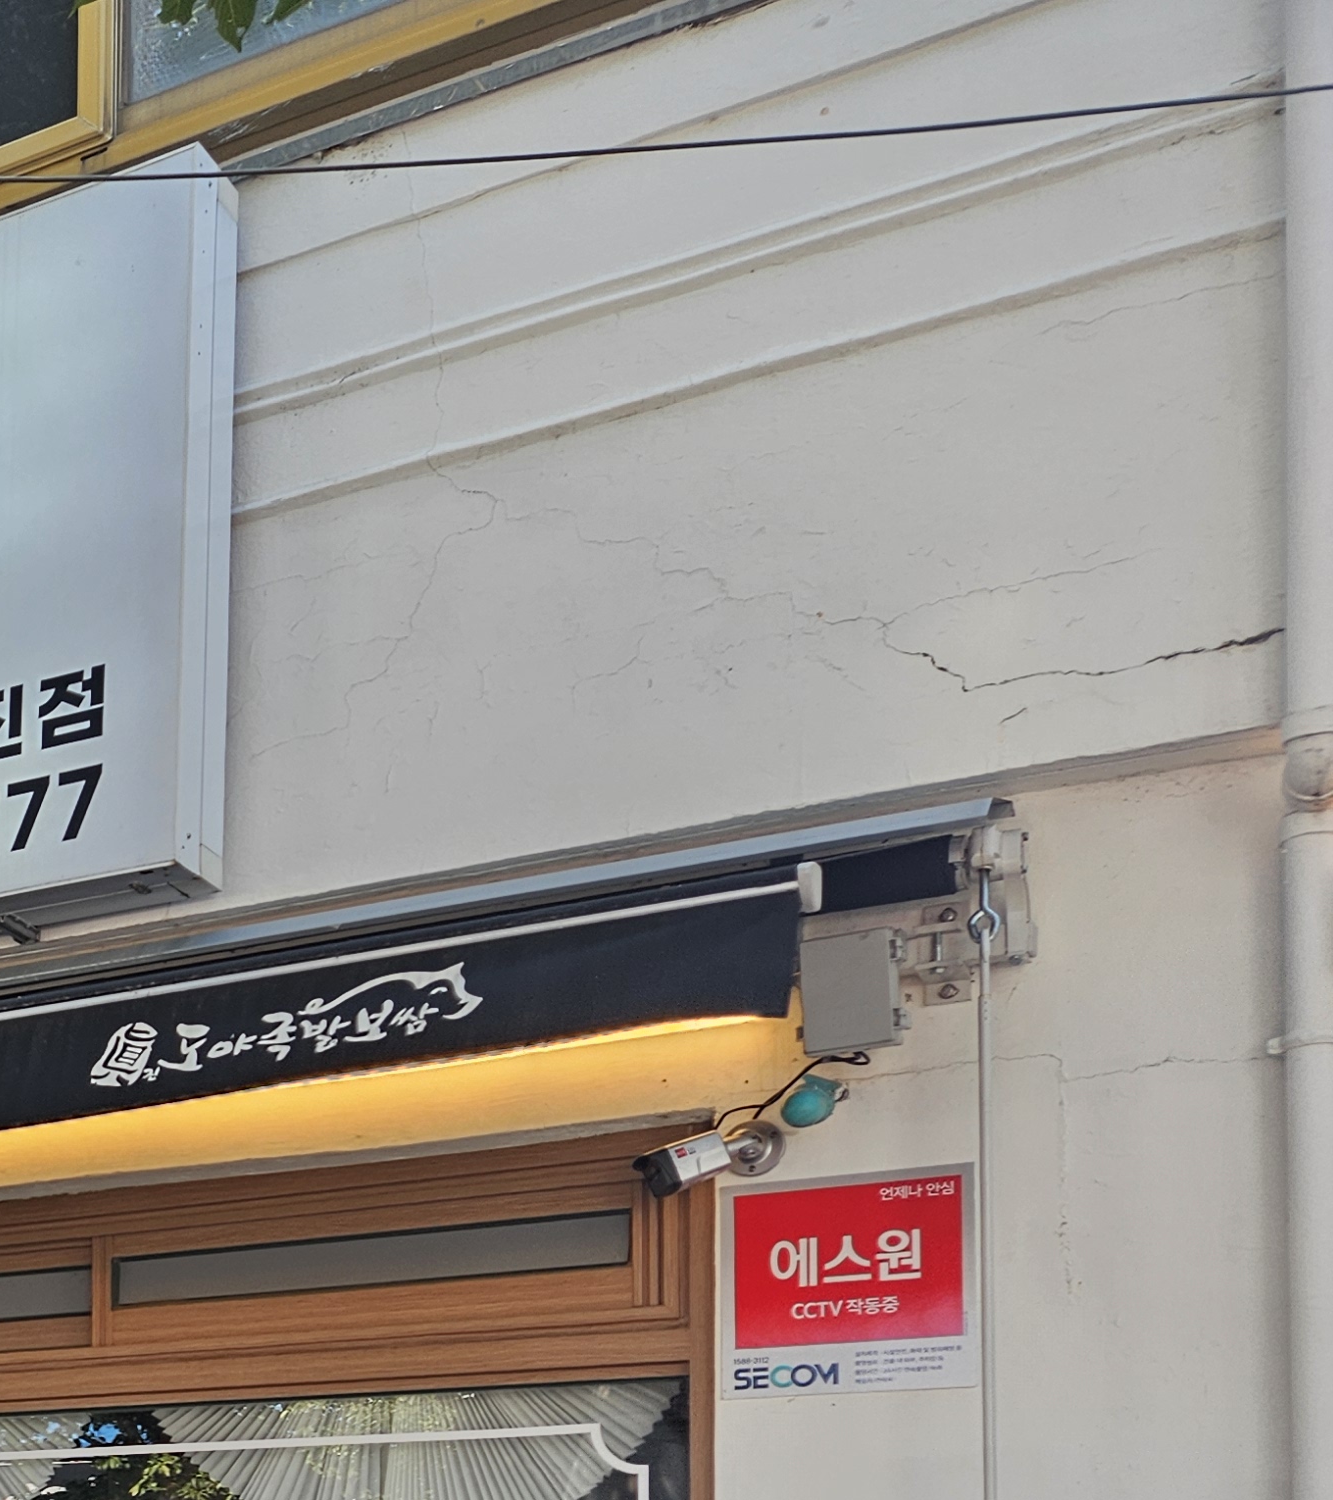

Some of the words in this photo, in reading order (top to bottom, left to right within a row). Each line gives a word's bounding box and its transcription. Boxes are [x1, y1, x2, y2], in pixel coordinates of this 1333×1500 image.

[879, 1183, 923, 1202] 언제나
[925, 1180, 955, 1197] 안심
[769, 1228, 923, 1288] 에스원
[790, 1299, 843, 1320] CCTV
[846, 1296, 900, 1316] 작동중
[734, 1362, 840, 1391] SECOM
